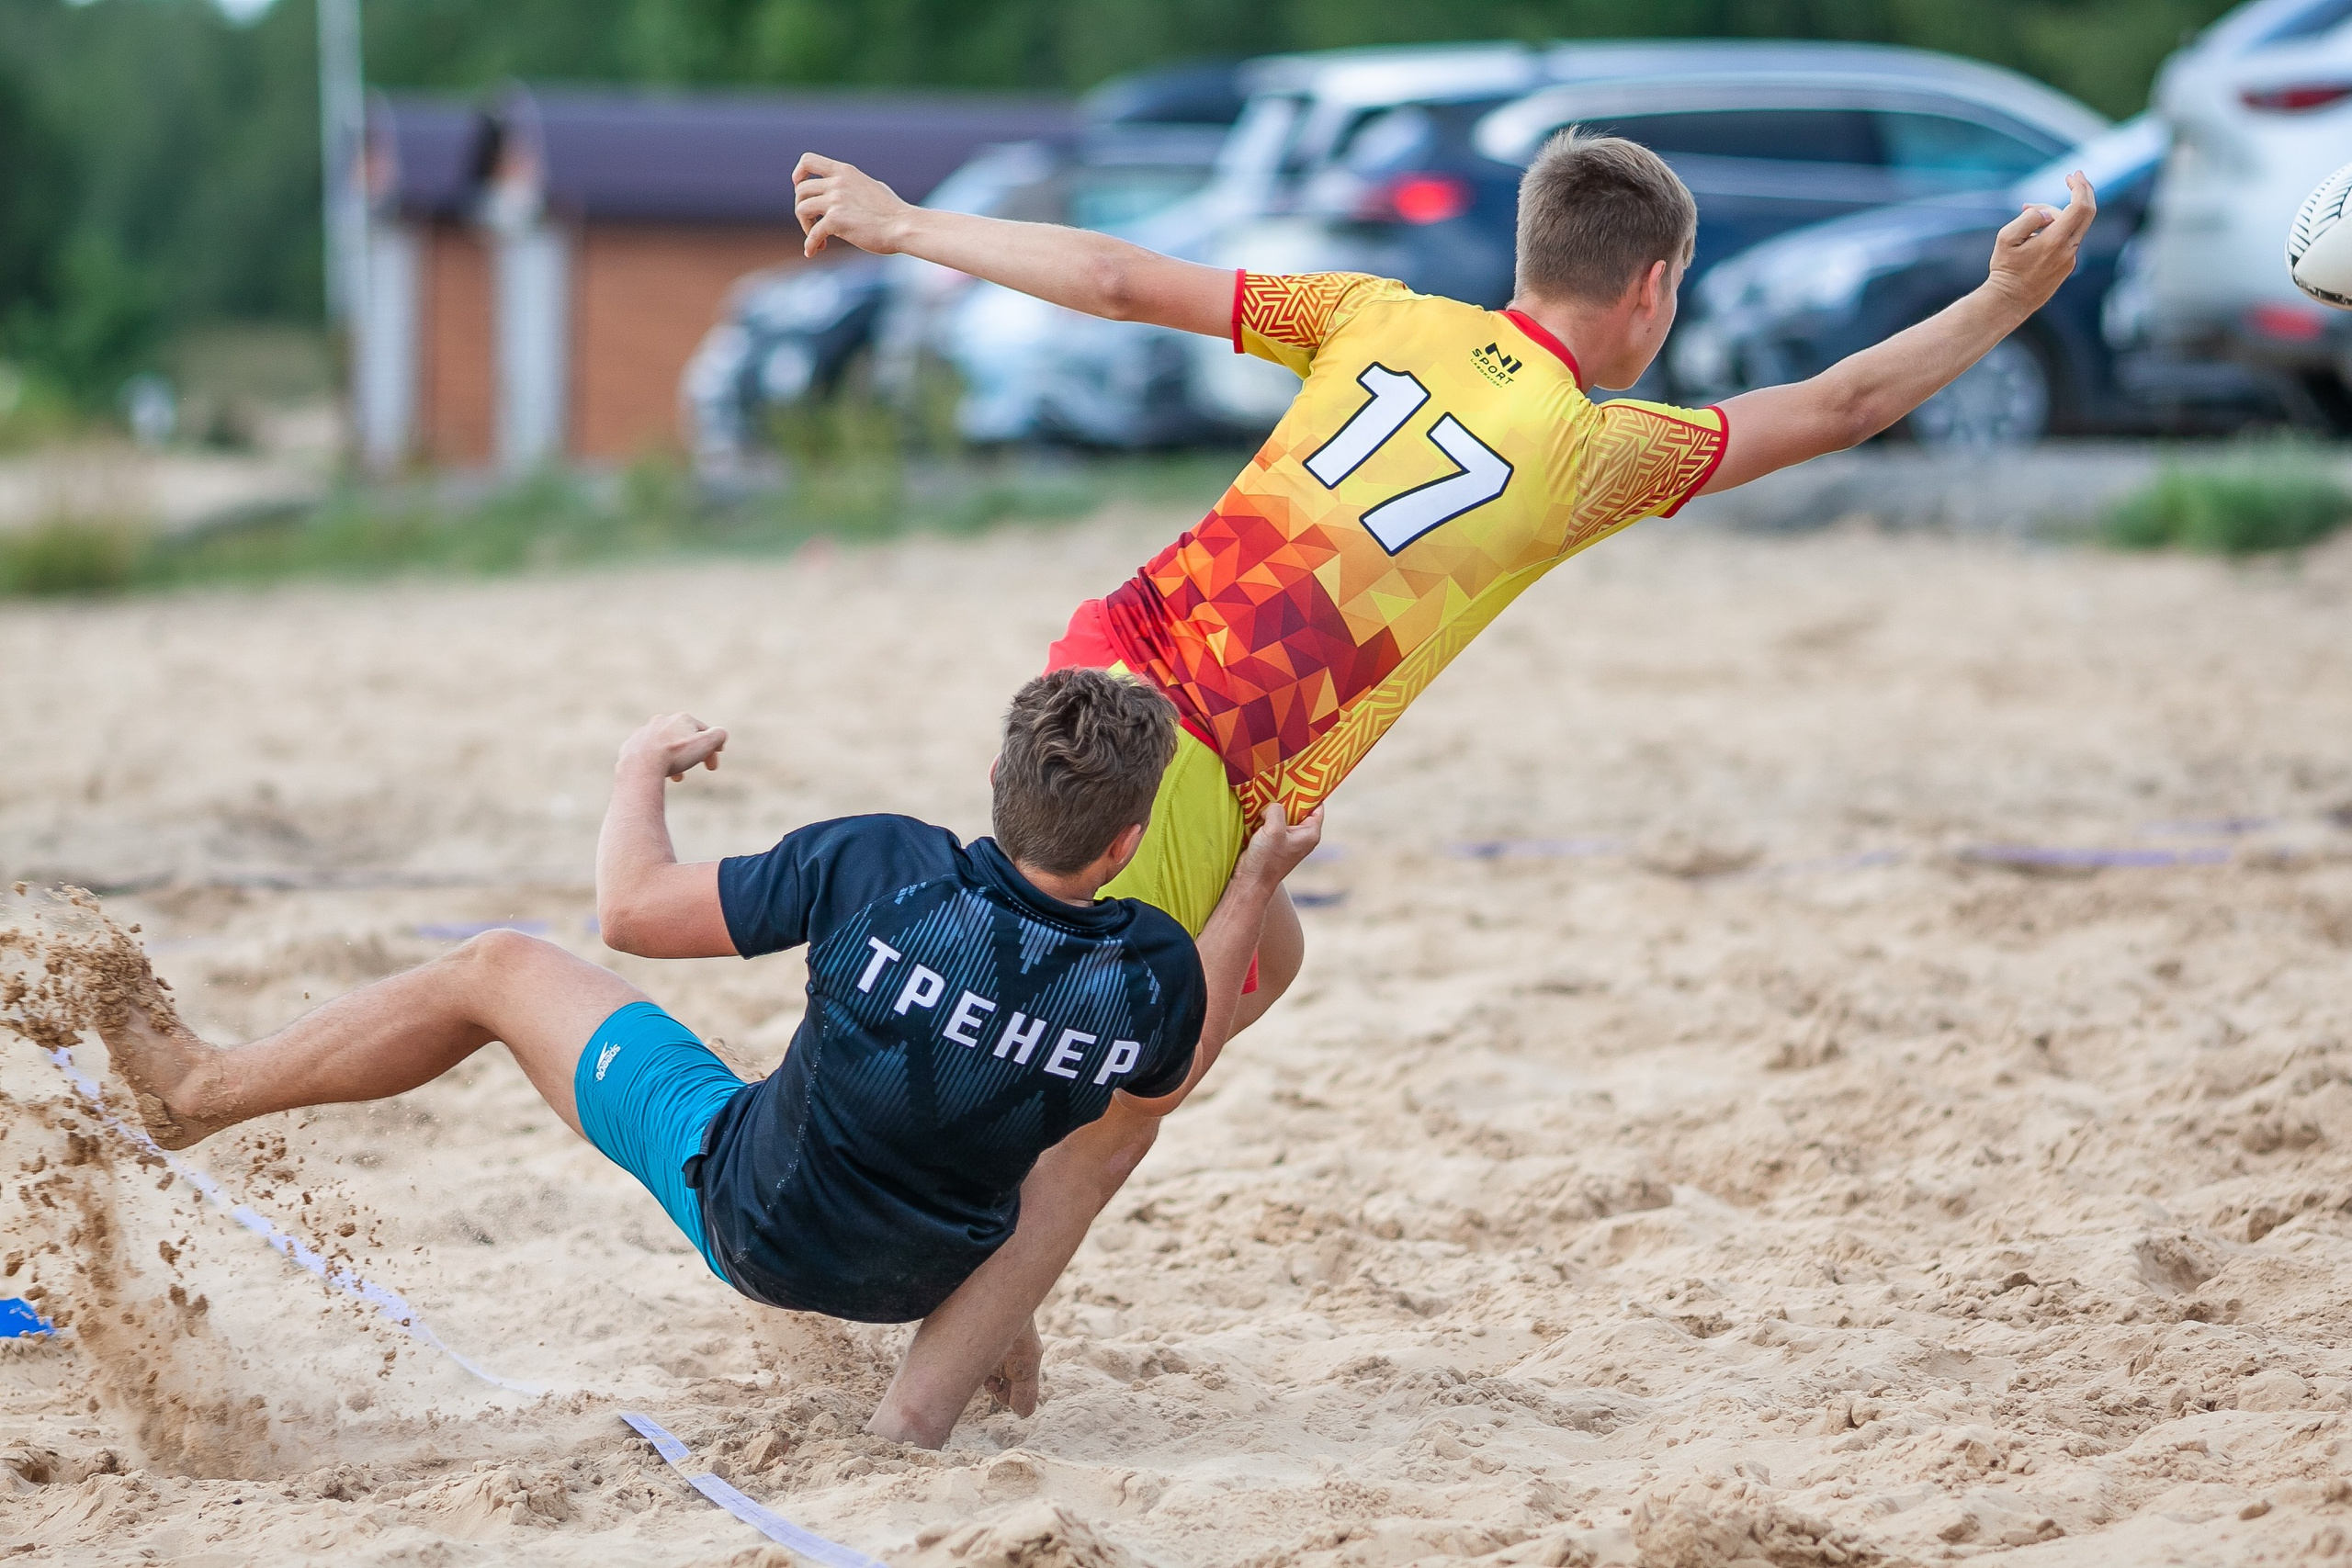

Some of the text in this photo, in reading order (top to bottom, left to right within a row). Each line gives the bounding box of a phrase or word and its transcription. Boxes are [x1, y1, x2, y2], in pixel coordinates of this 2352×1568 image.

[1472, 348, 1514, 384] SPORT
[1302, 361, 1514, 557] 17
[856, 936, 1141, 1085] ТРЕНЕР
[595, 1043, 621, 1081] speedo
